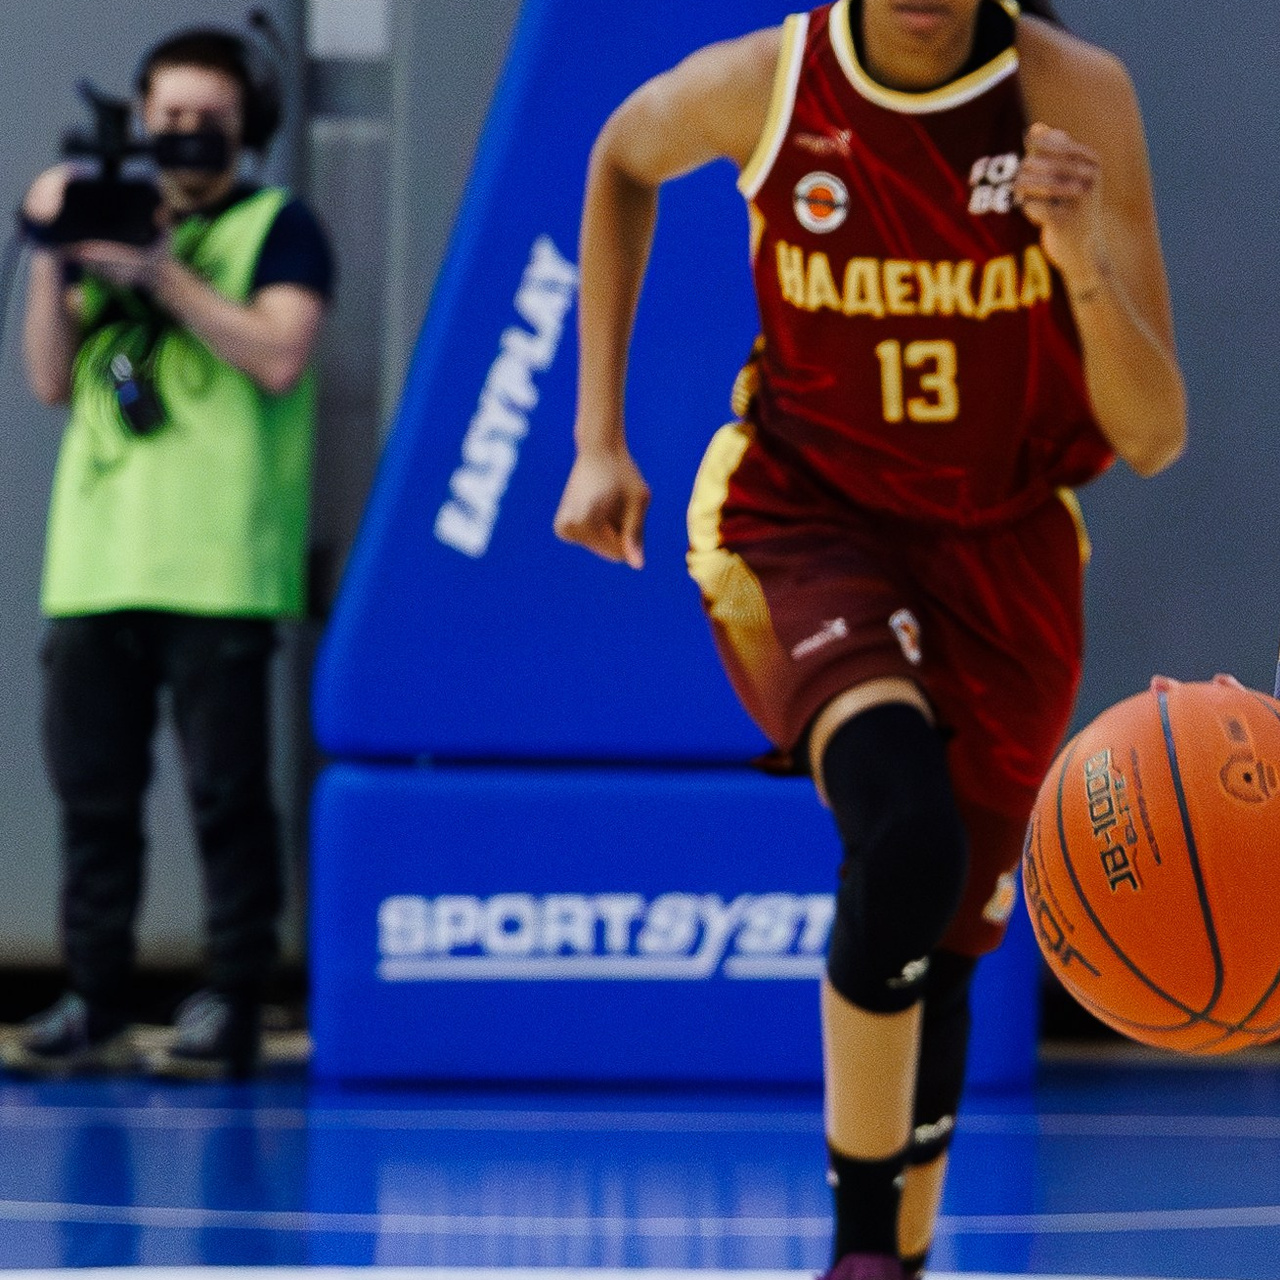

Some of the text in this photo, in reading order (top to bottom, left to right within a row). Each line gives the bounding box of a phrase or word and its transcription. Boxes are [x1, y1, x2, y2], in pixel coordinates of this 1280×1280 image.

[968, 152, 1020, 186] FO
[774, 239, 1053, 320] НАДЕЖДА
[875, 339, 960, 424] 13
[377, 892, 838, 970] SPORTSYST
